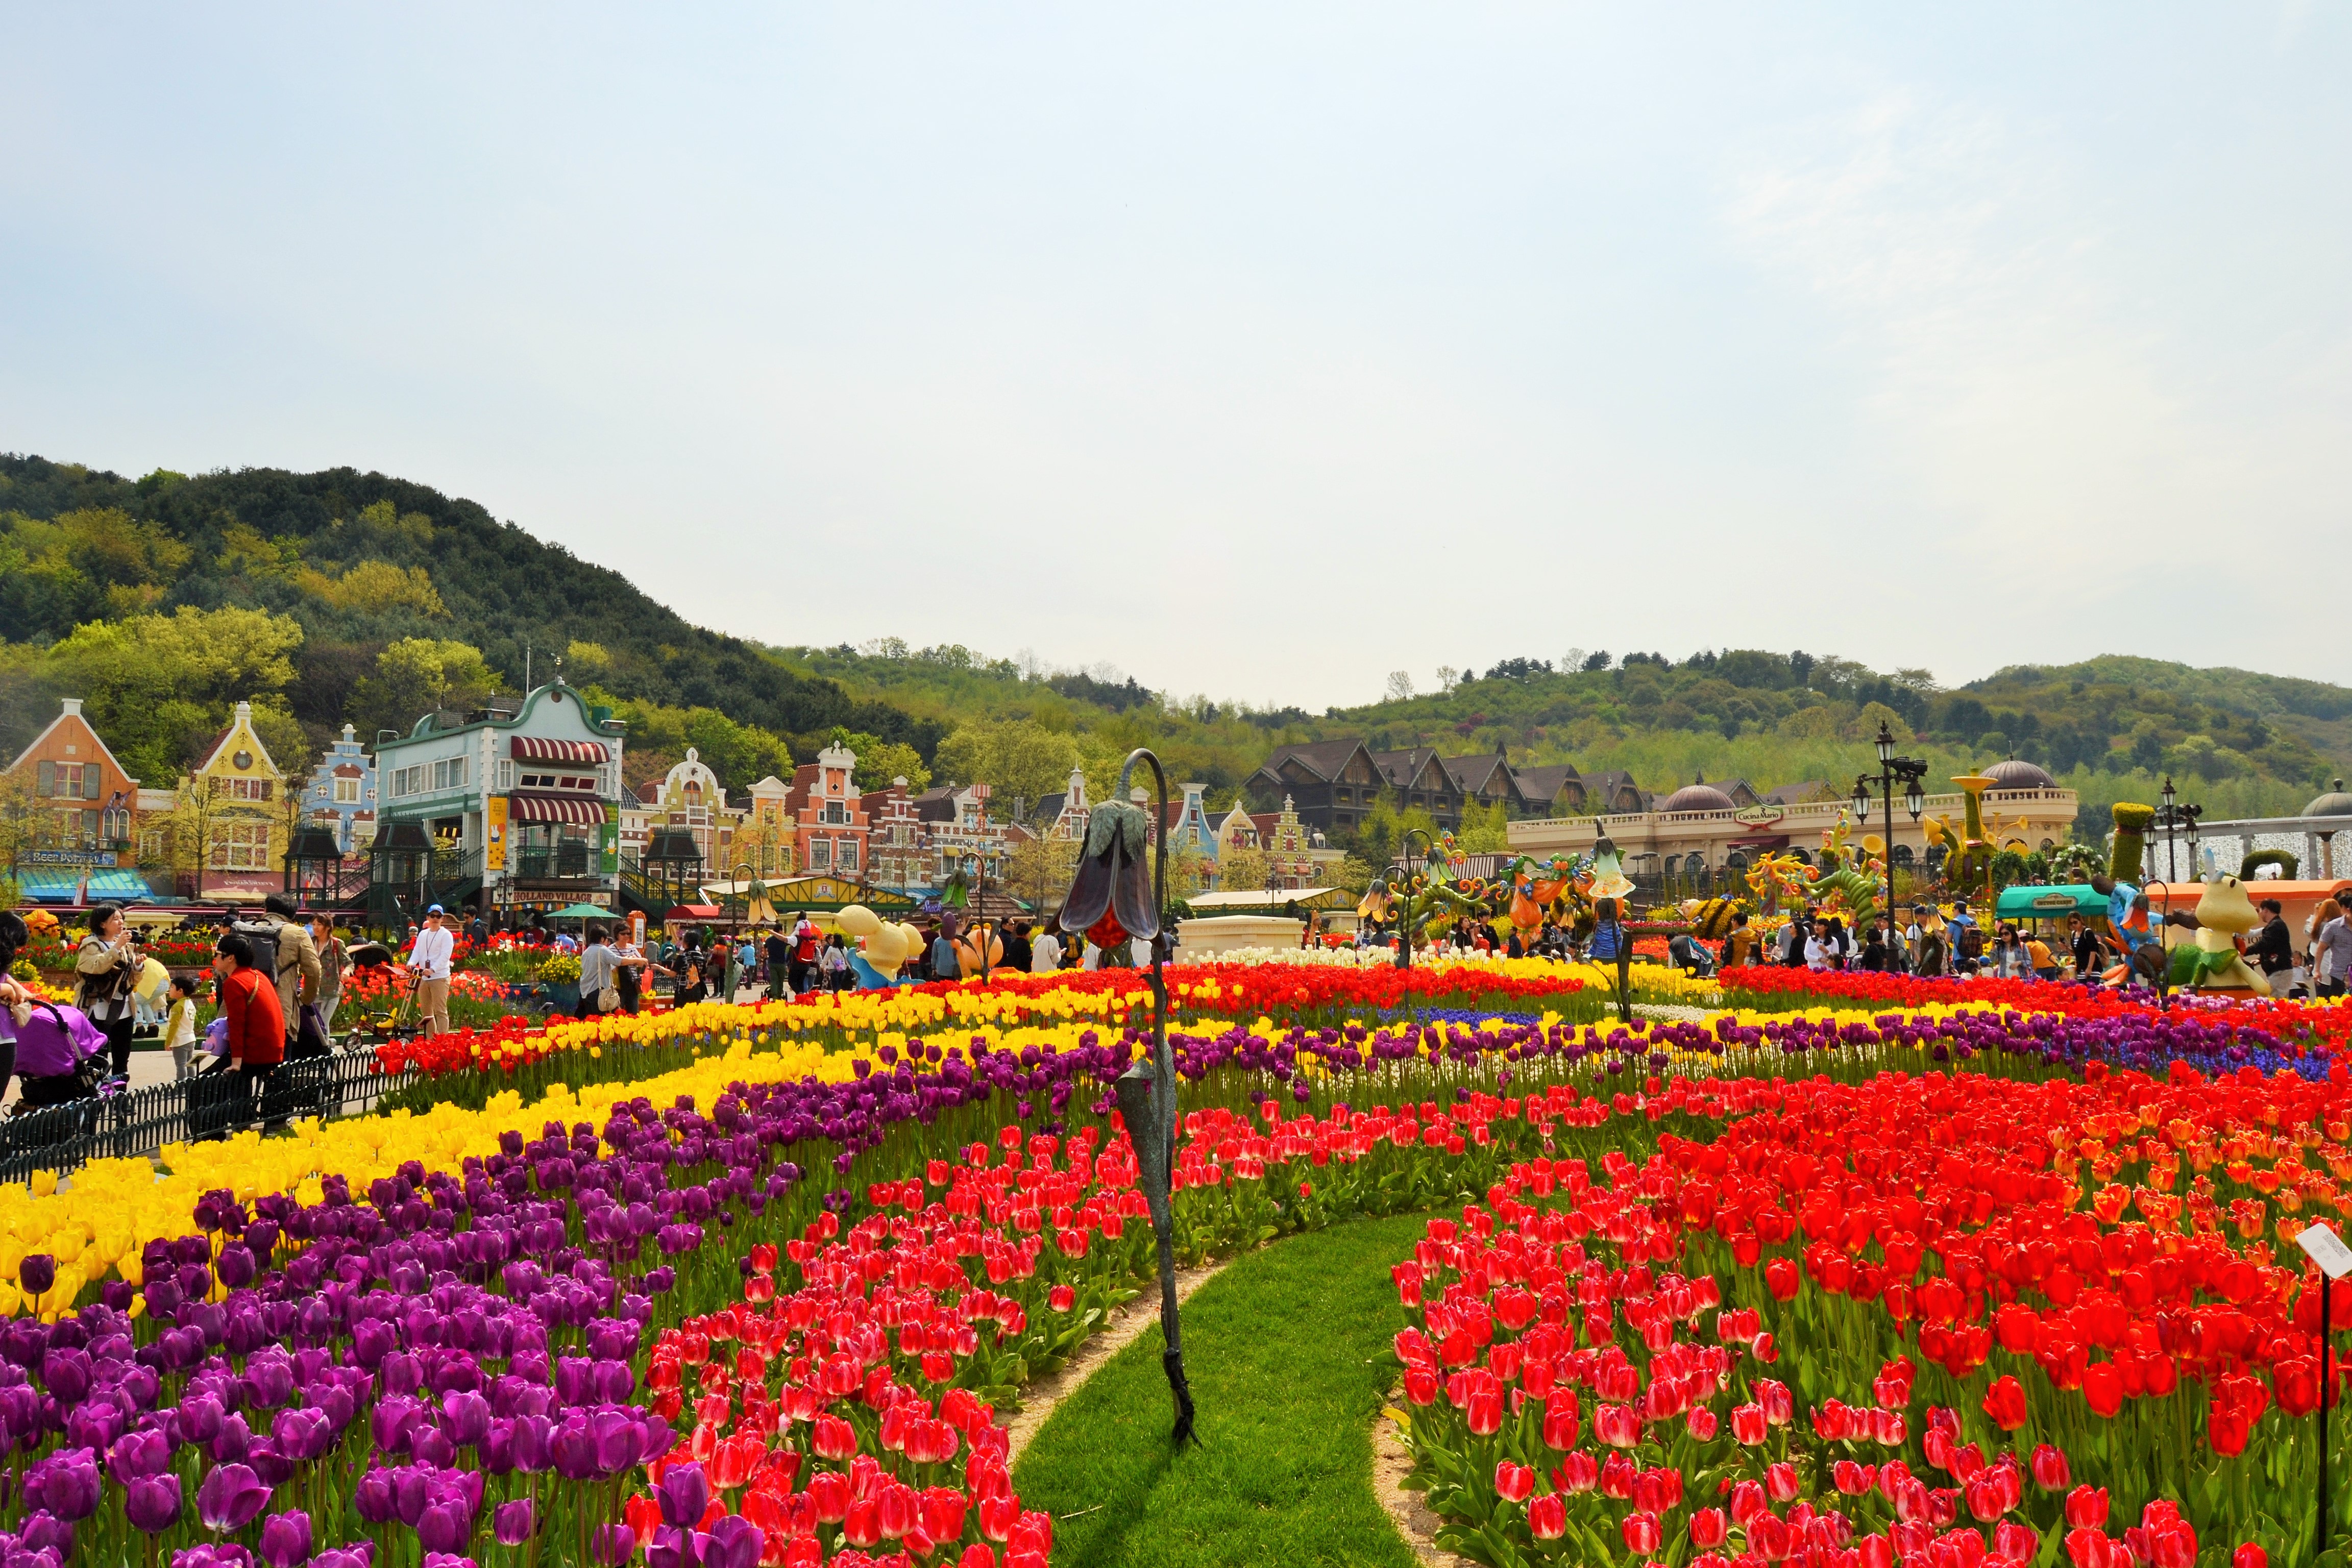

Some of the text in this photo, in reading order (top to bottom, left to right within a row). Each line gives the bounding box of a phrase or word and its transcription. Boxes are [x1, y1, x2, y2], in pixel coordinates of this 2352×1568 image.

[513, 892, 592, 903] HOLLAND VILLAGE
[923, 900, 942, 913] Snack
